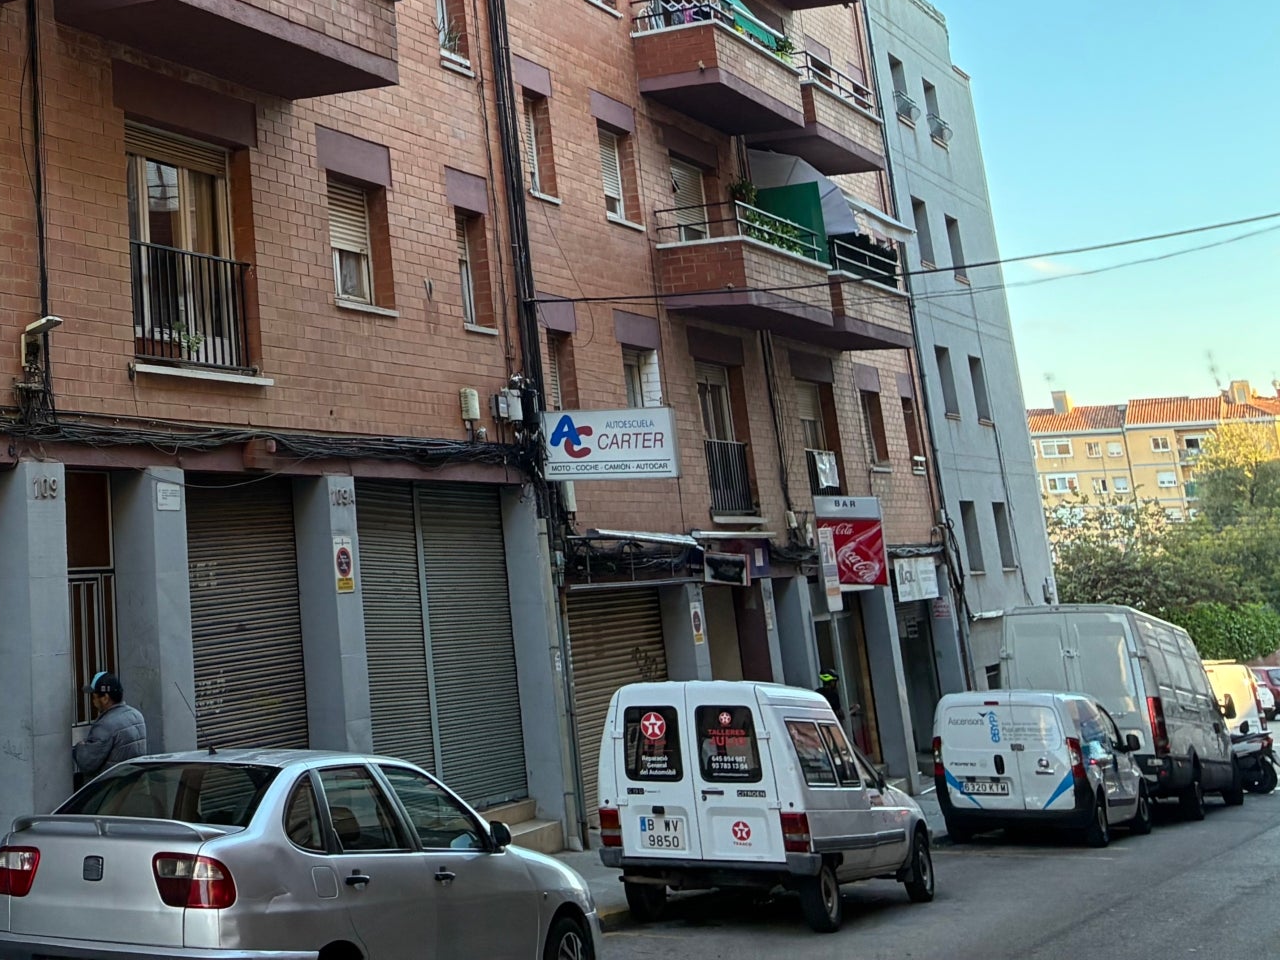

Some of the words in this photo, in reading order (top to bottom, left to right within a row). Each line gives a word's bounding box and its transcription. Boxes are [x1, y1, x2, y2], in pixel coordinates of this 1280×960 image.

[605, 419, 655, 430] AUTOESCUELA
[597, 432, 664, 450] CARTER
[551, 464, 571, 472] MOTO
[576, 463, 599, 471] COCHE
[635, 462, 668, 470] AUTOCAR
[33, 477, 58, 500] 109
[834, 500, 856, 508] BAR
[948, 717, 985, 726] Ascensors
[964, 782, 987, 792] 6320
[989, 782, 1007, 792] KTM
[647, 819, 654, 830] B
[664, 820, 678, 831] WV
[648, 835, 680, 847] 9850
